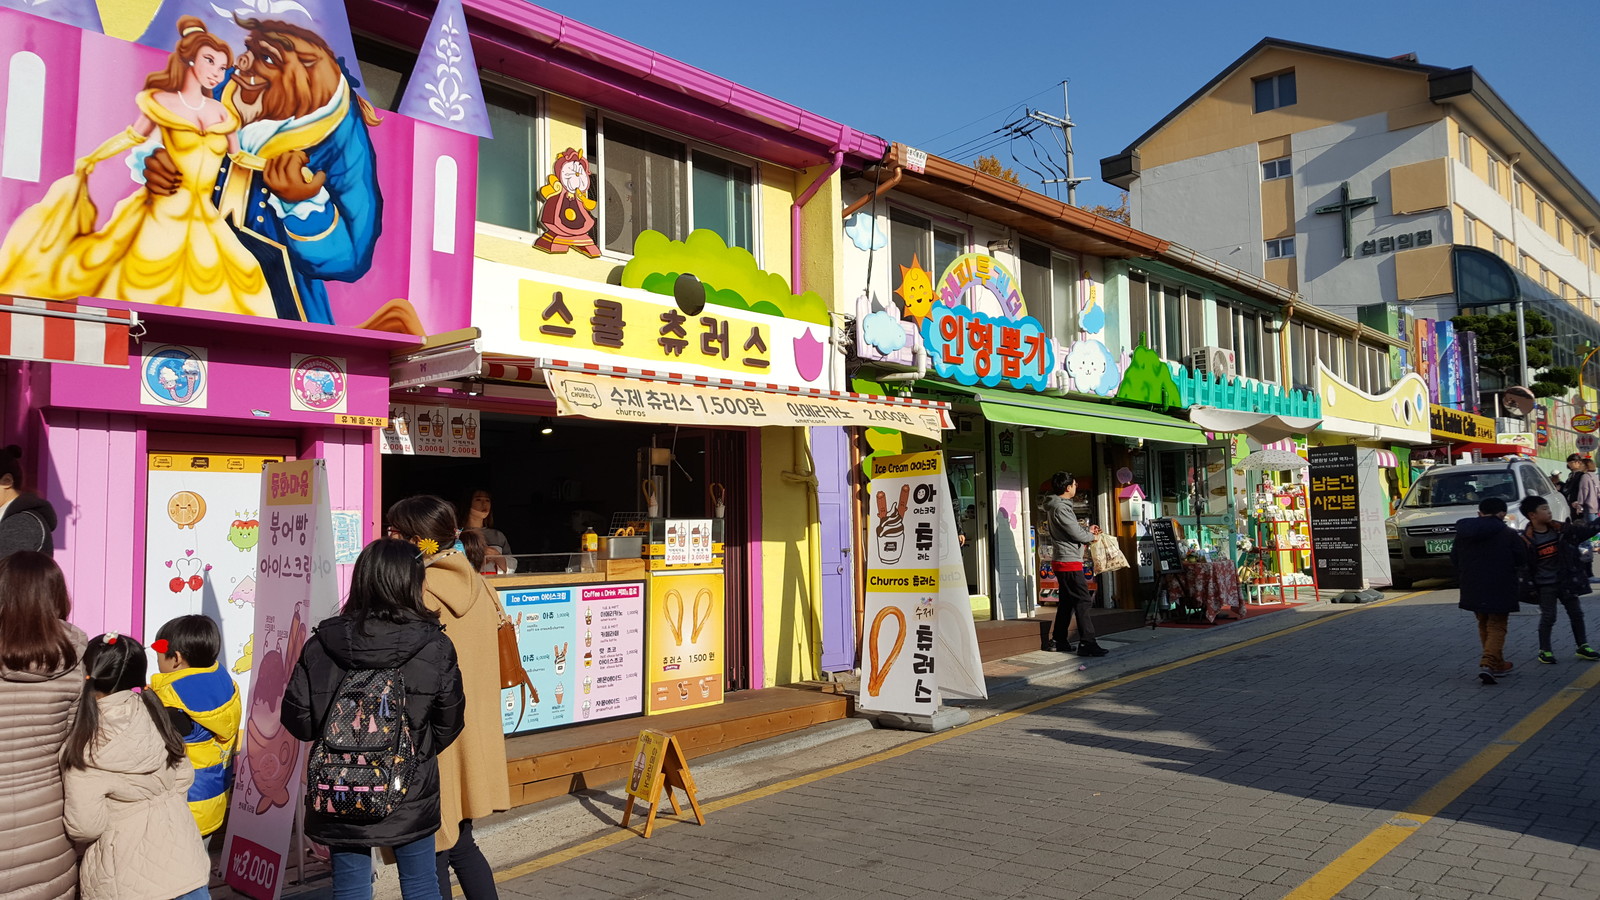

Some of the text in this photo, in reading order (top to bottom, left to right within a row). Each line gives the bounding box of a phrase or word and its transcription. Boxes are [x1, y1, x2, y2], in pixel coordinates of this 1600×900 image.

[539, 291, 770, 368] 스쿨 츄러스
[610, 386, 644, 408] 수제
[647, 390, 694, 412] 츄러스
[616, 408, 646, 417] churros
[786, 402, 854, 419] 아메리카노
[874, 458, 937, 474] Ice Cream 아이스크림
[271, 470, 308, 499] 동화마을
[1312, 475, 1354, 492] 남는건
[913, 483, 937, 504] 아
[914, 506, 936, 514] 이스크림
[1314, 494, 1356, 510] 사진뿐
[270, 512, 308, 546] 붕어빵
[870, 575, 935, 586] Churros 츄러스
[541, 592, 567, 600] 아이스크림
[915, 606, 934, 620] 수제
[599, 657, 623, 665] 아이스초코
[663, 656, 682, 664] 츄러스
[709, 652, 715, 661] 원
[913, 624, 934, 703] 츄러스
[597, 675, 622, 683] 레몬에이드
[596, 698, 620, 706] 자몽에이드
[234, 850, 274, 889] ₩3,000
